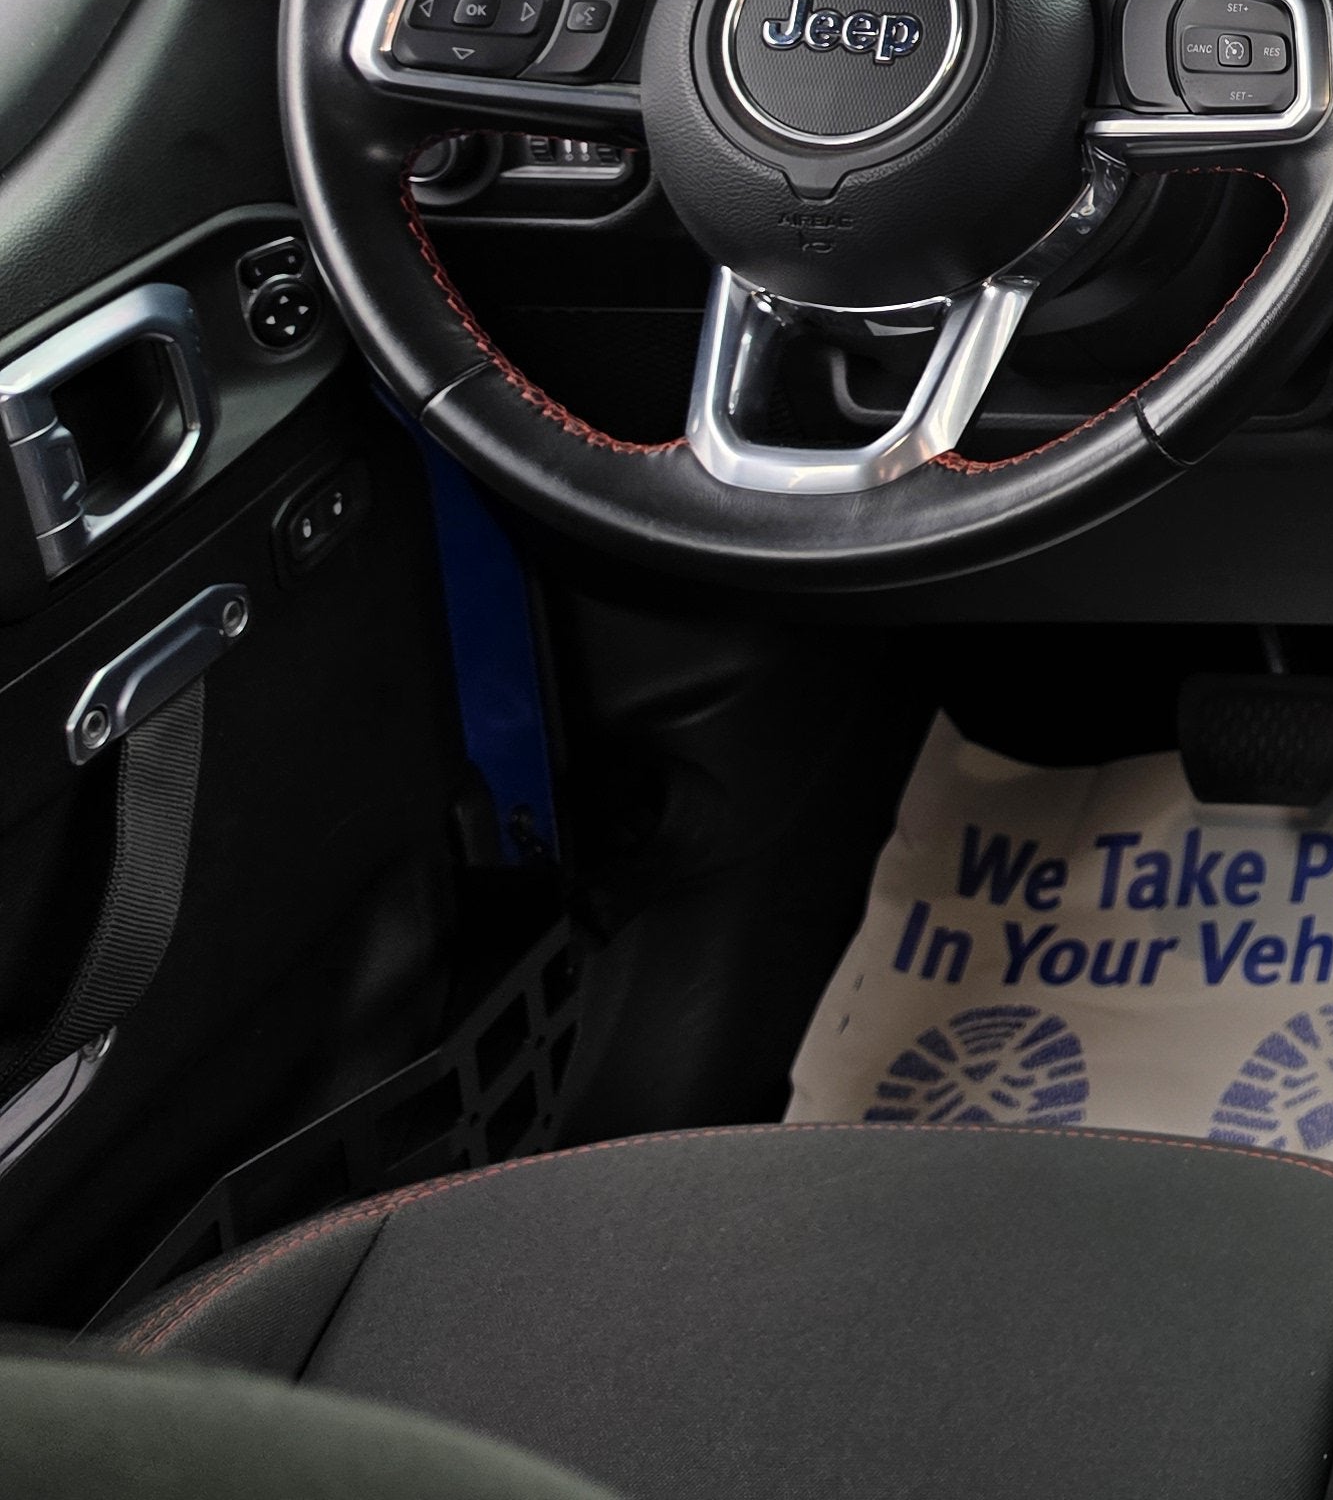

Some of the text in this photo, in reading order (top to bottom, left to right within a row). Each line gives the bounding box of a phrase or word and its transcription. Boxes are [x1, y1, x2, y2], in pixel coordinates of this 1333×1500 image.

[466, 3, 487, 16] OK
[1227, 3, 1249, 13] SET+
[1186, 43, 1213, 54] CANC
[1263, 47, 1281, 57] RES
[957, 824, 1067, 912] We
[1095, 831, 1267, 912] Take
[893, 901, 974, 984] In
[1001, 922, 1178, 986] Your
